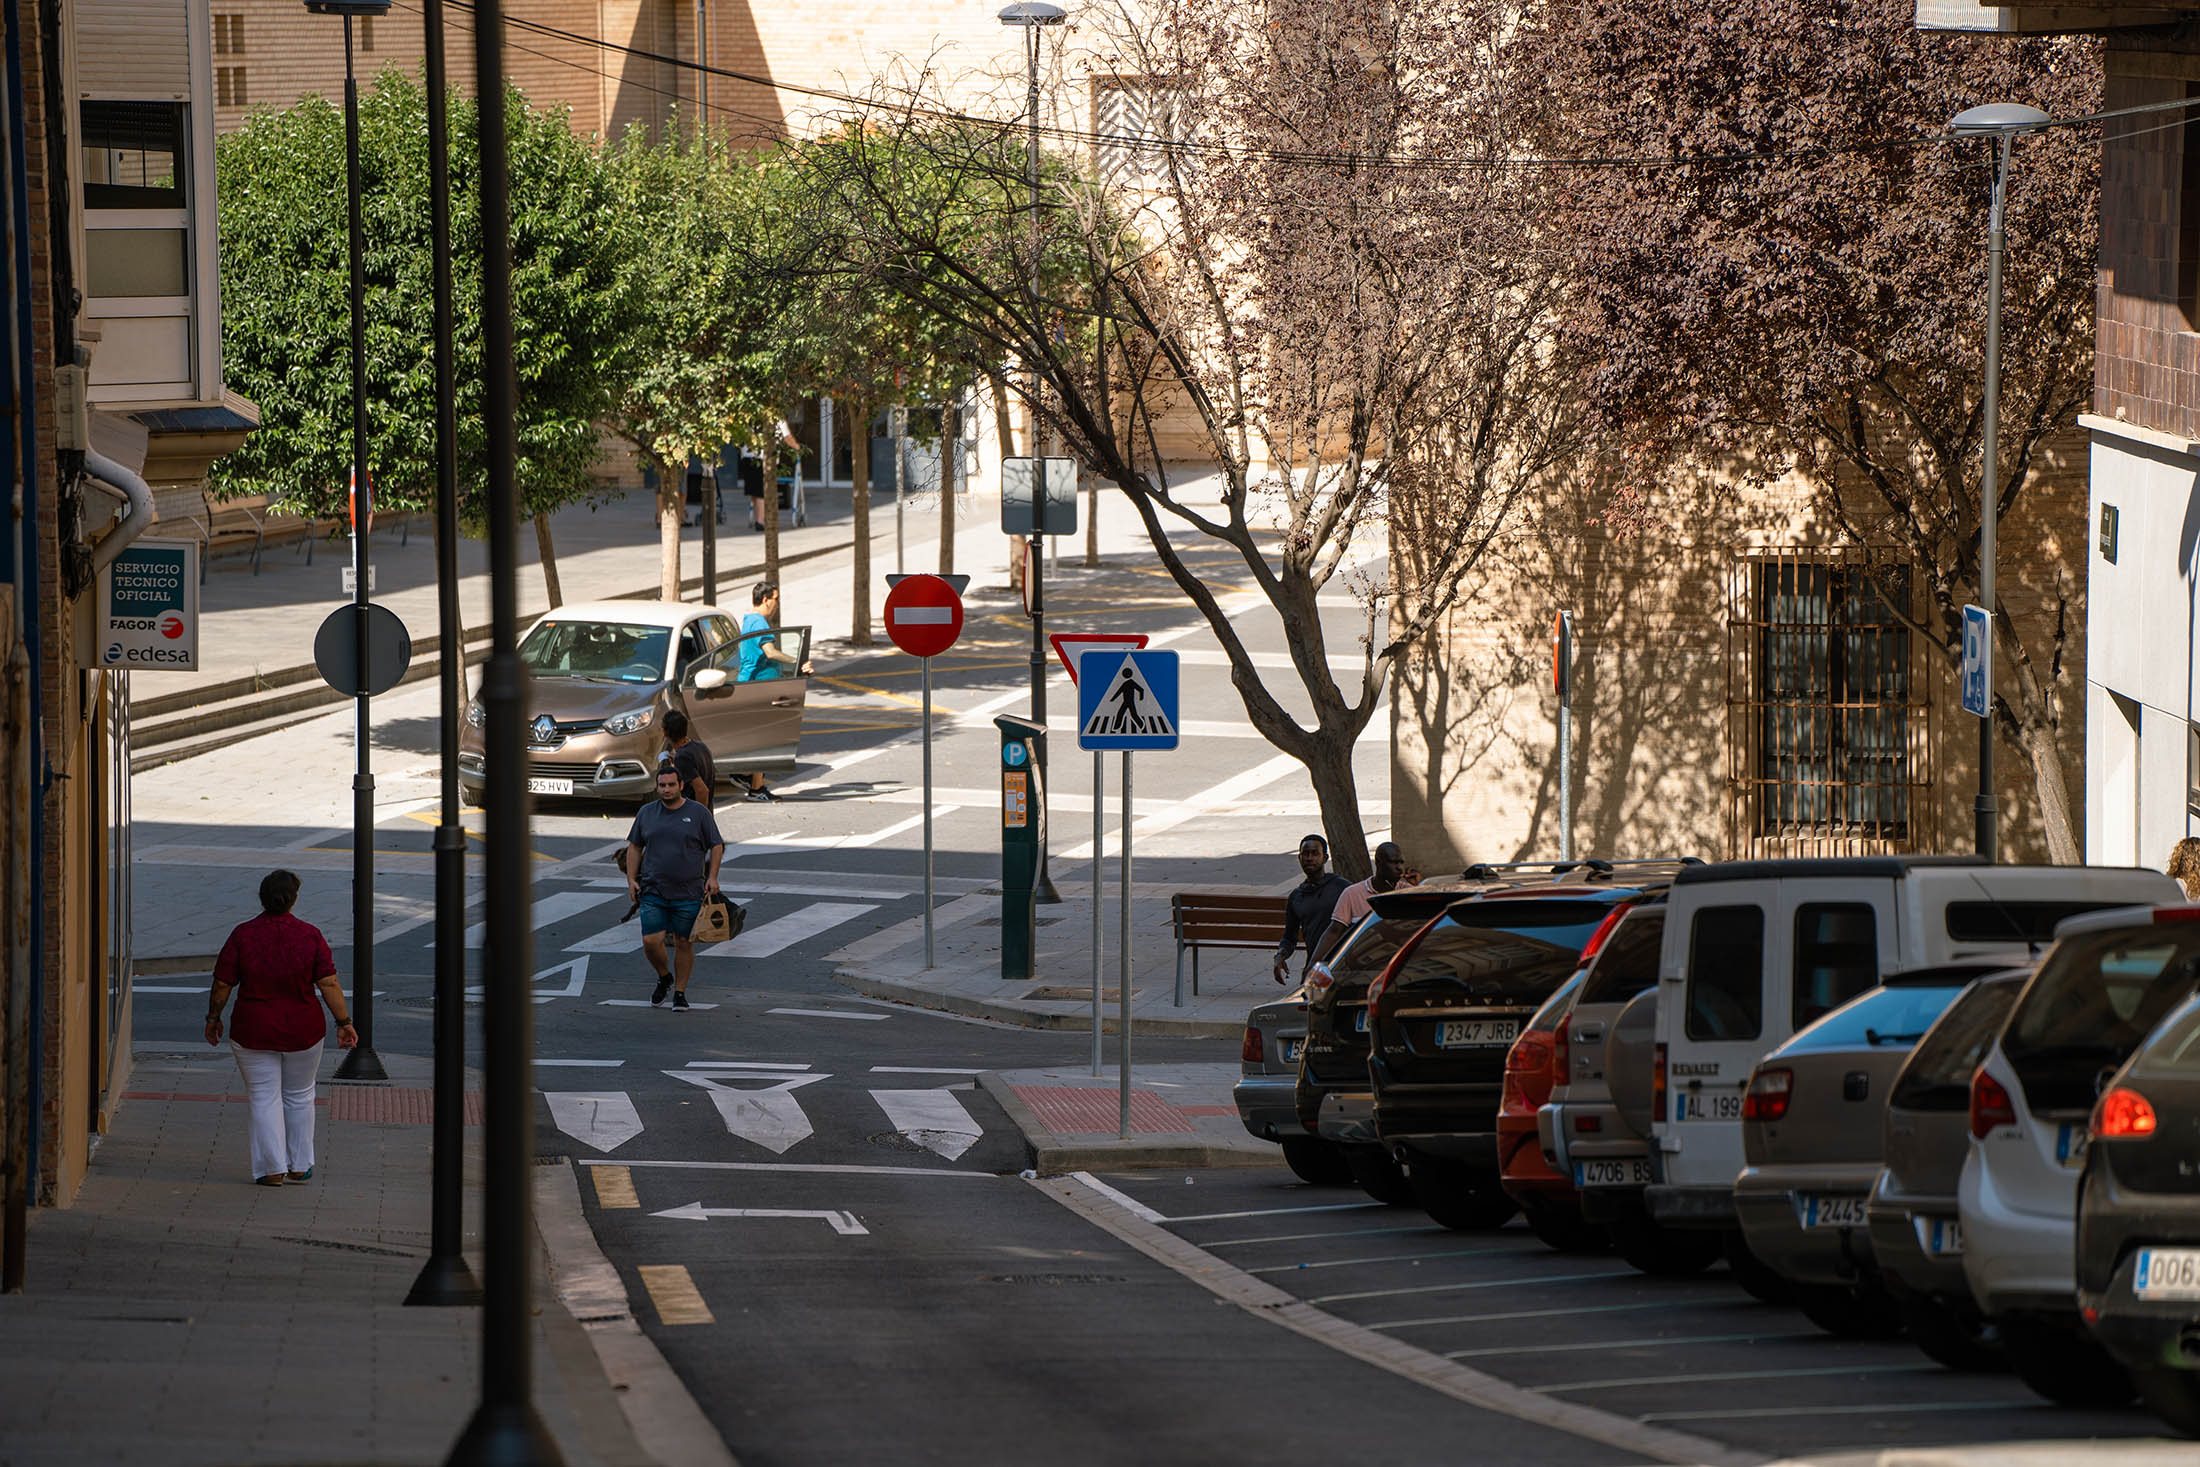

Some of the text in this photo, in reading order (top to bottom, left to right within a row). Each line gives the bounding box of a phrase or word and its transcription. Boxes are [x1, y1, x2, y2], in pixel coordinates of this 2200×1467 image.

[115, 563, 179, 575] SERVICIO
[115, 577, 178, 588] TECNICO
[115, 590, 171, 601] OFICIAL
[110, 620, 156, 631] FAGOR
[126, 646, 190, 663] edesa
[1010, 743, 1023, 765] P
[1446, 1022, 1515, 1042] 2347 JRB
[1587, 1161, 1625, 1183] 4706
[1821, 1200, 1865, 1223] 2445
